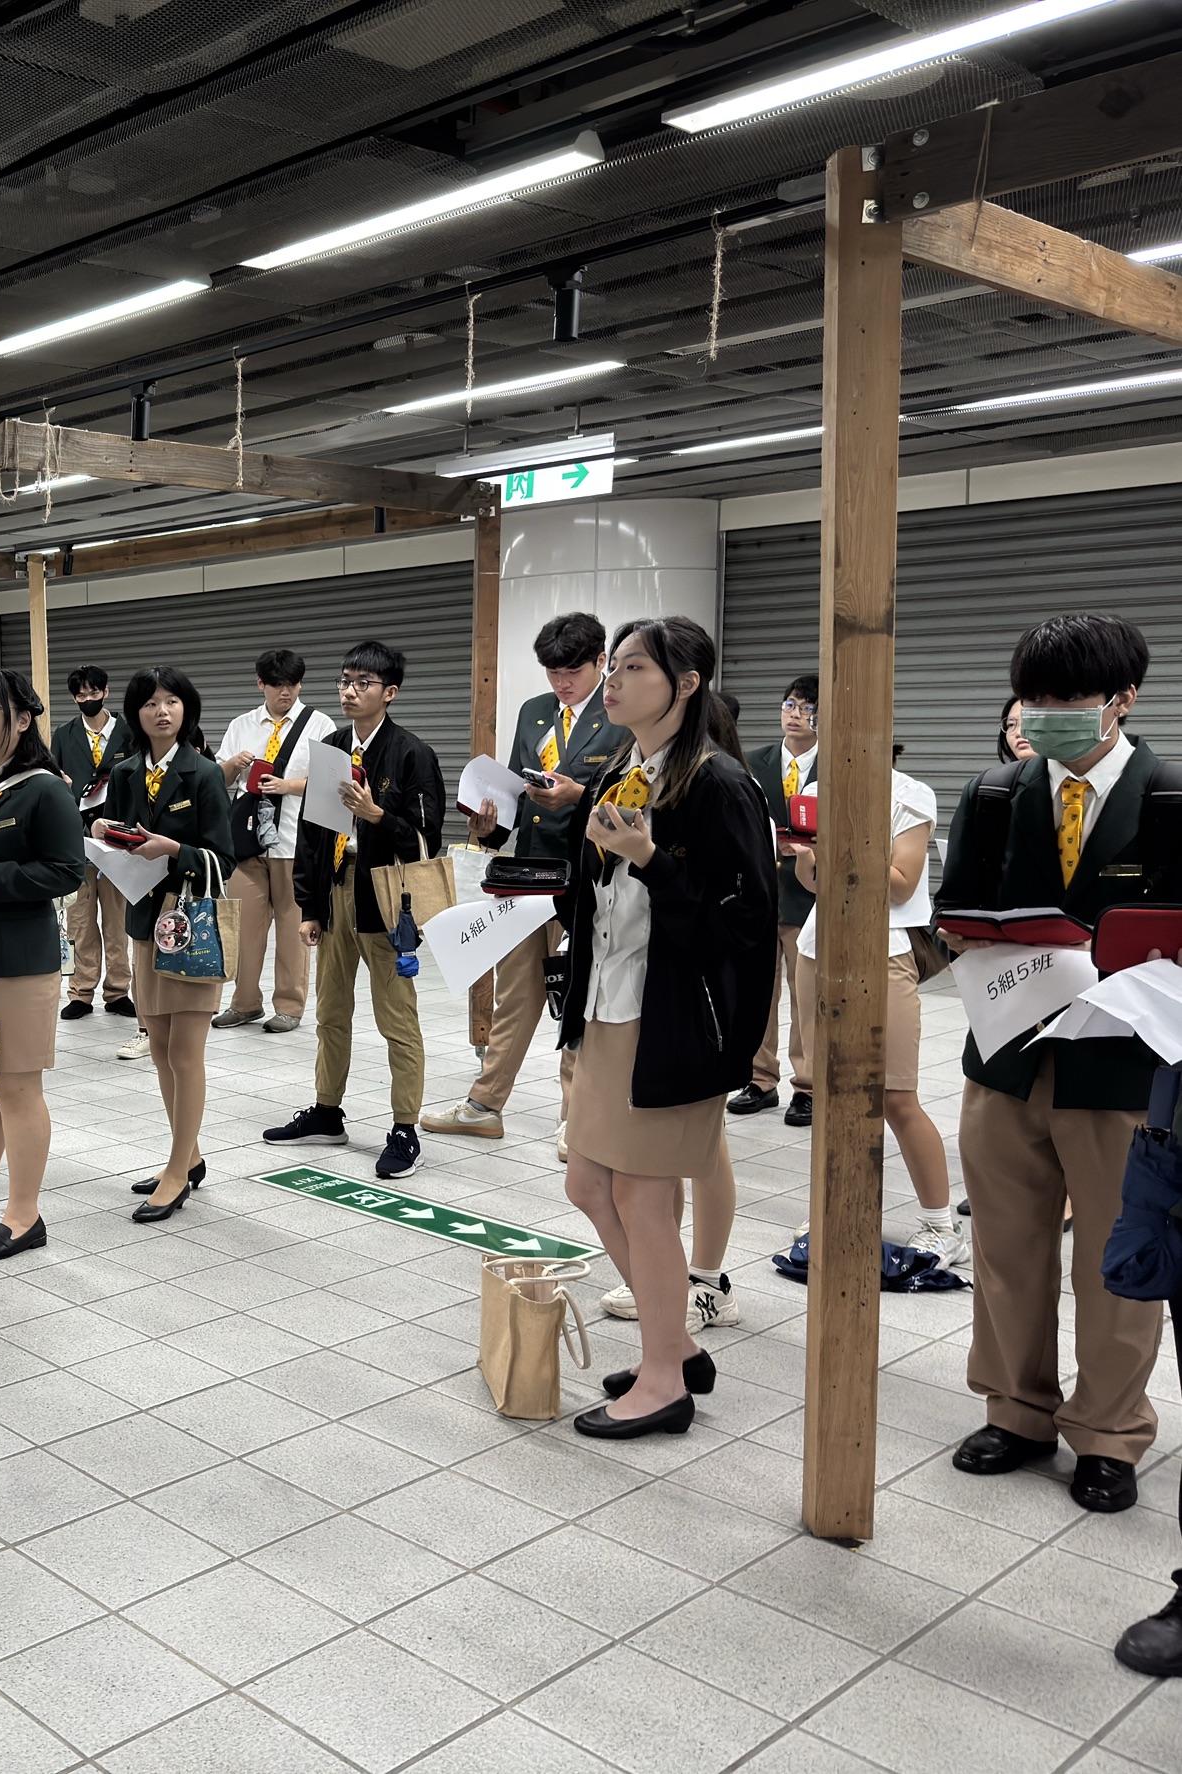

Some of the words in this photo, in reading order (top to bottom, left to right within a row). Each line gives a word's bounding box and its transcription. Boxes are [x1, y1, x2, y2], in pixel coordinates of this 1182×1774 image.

[460, 898, 516, 945] 4組1班
[986, 952, 1054, 1001] 5組5班
[291, 1175, 324, 1186] EXIT
[694, 1291, 720, 1323] NY
